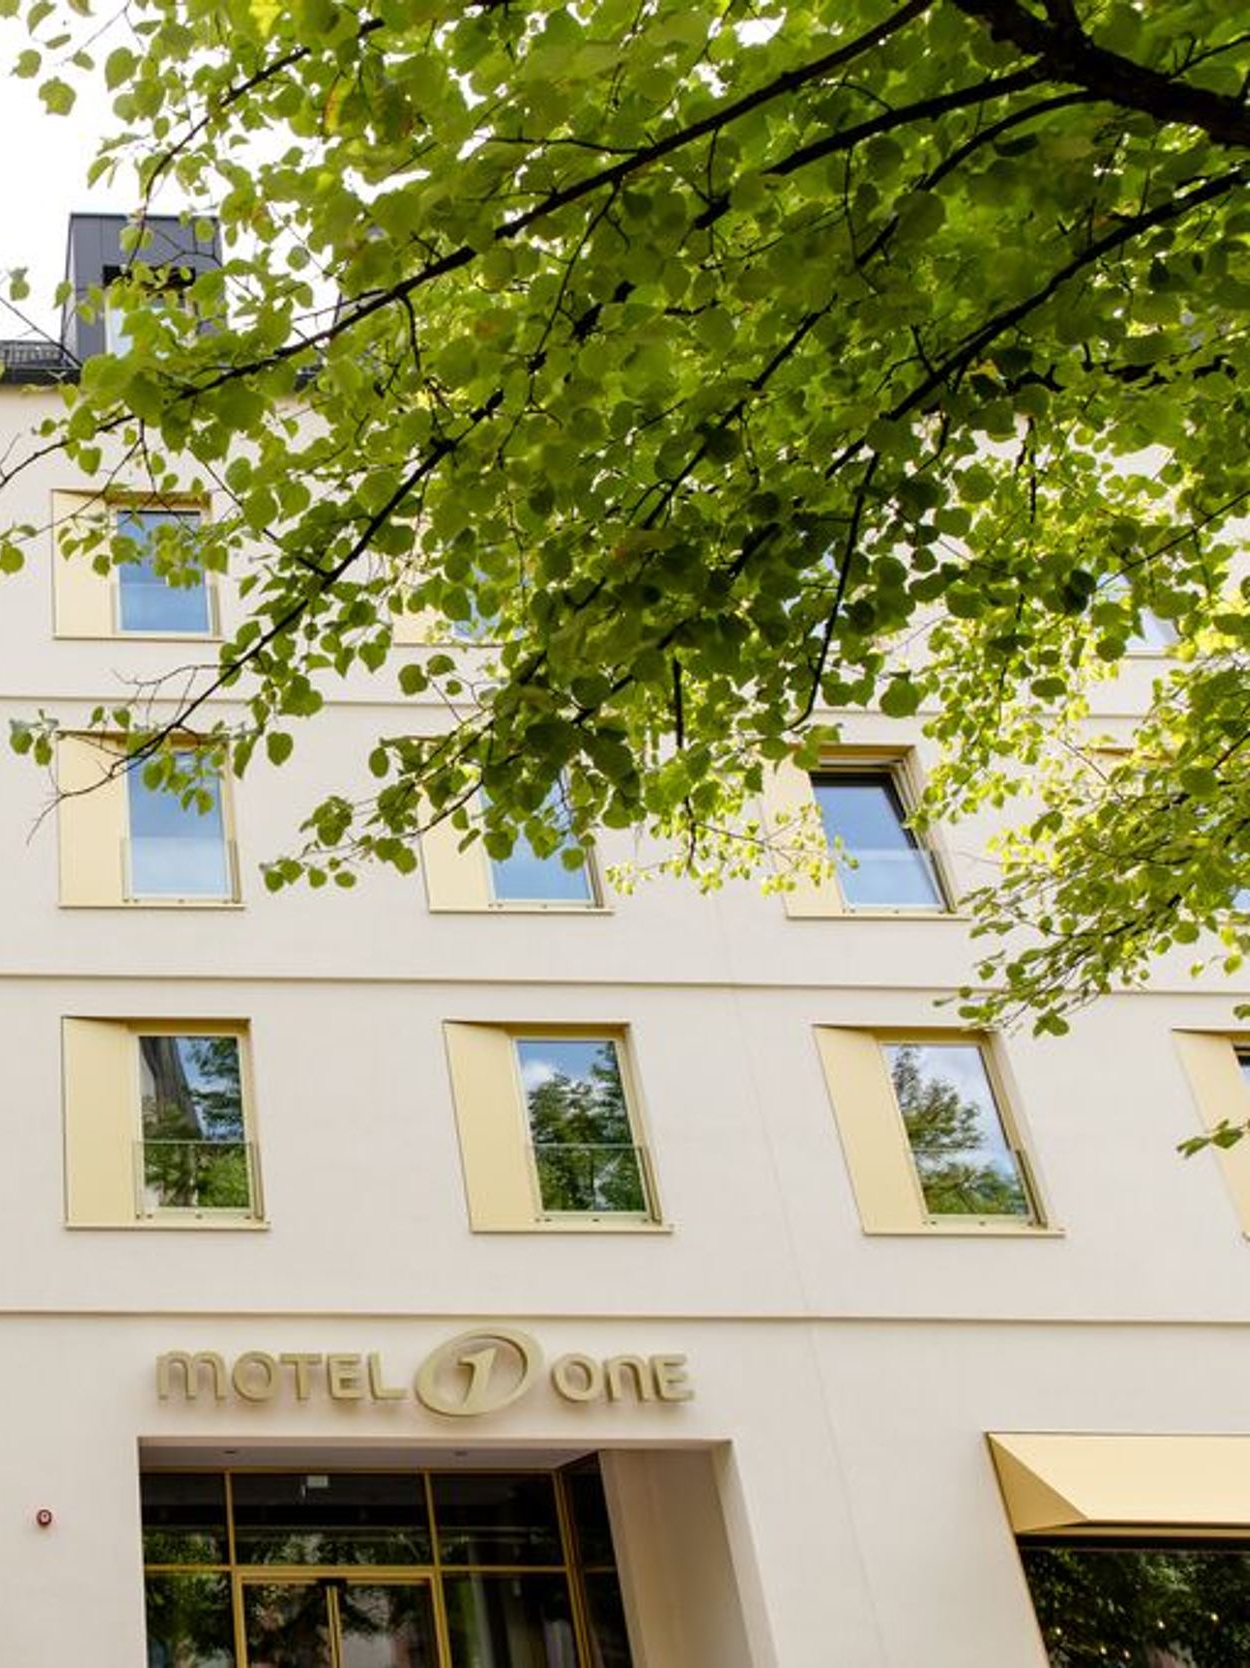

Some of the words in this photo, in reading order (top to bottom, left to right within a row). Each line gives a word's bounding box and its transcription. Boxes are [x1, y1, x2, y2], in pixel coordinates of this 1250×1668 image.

[156, 1350, 406, 1402] MOTEL
[453, 1347, 497, 1409] 1
[552, 1353, 694, 1402] ONE
